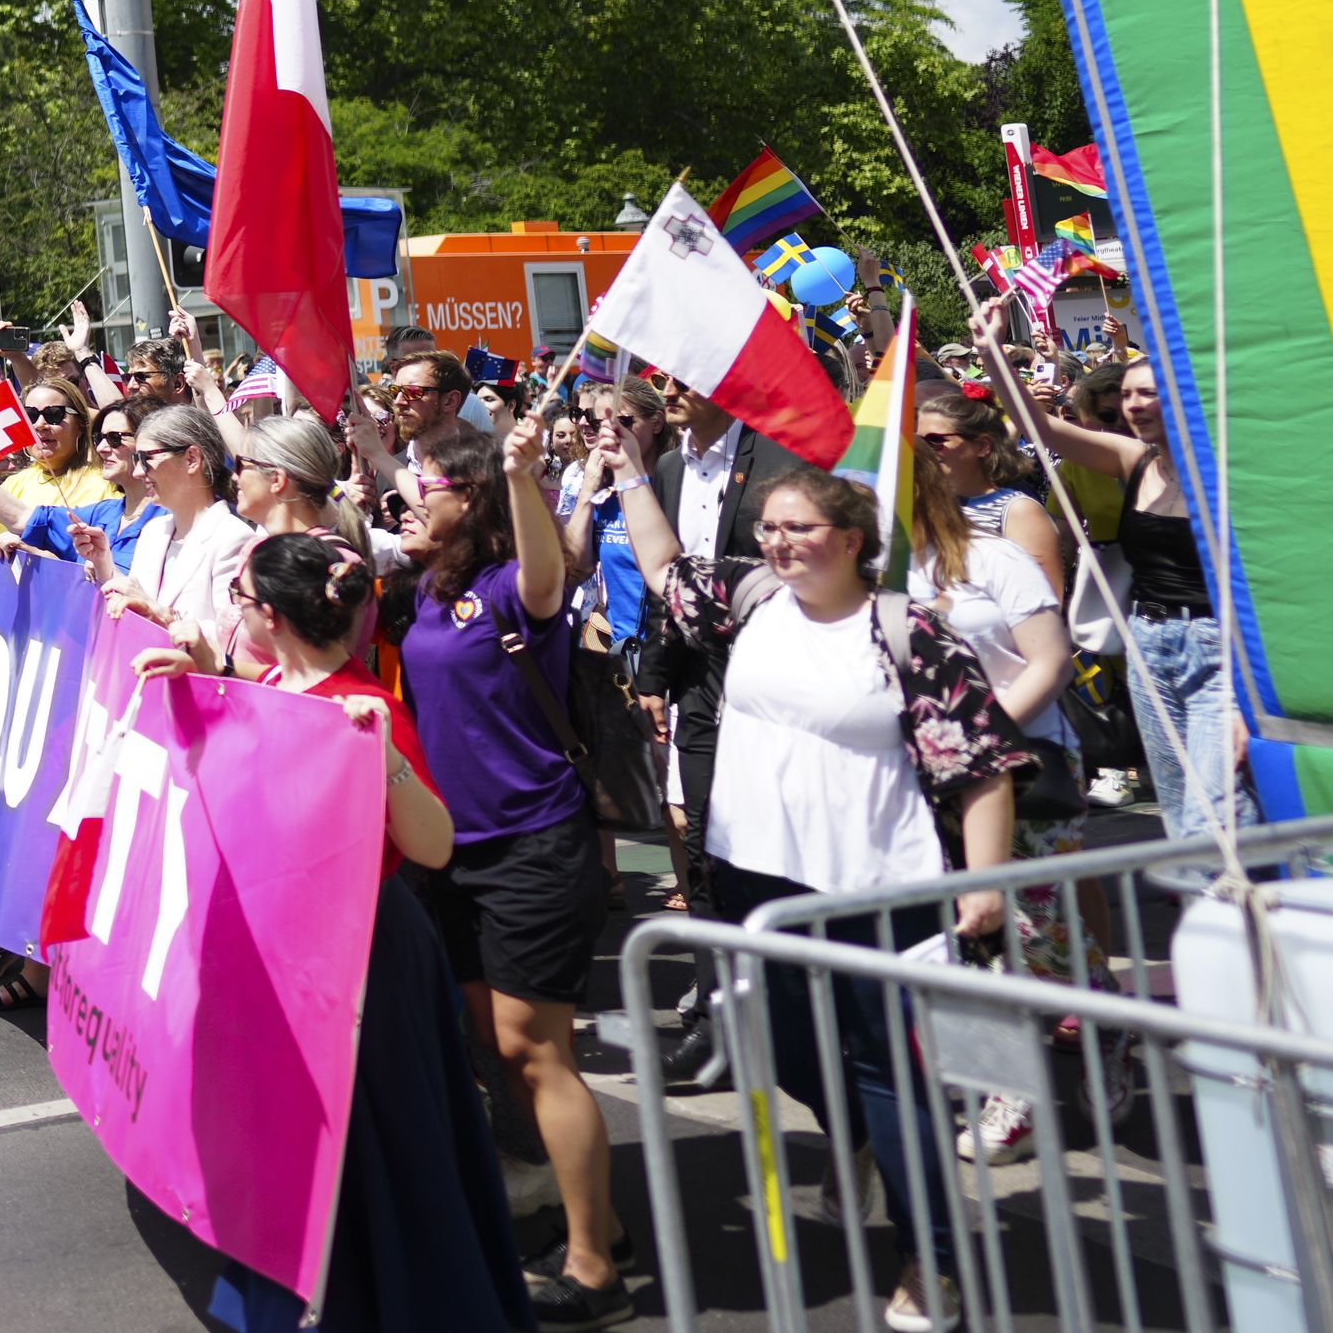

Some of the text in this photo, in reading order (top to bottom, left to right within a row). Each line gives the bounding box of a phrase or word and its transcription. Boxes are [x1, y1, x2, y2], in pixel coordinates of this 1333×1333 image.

[1013, 165, 1029, 229] WIENER LINIEN
[1097, 246, 1122, 254] rgtheat
[427, 298, 522, 331] MÜSSEN?
